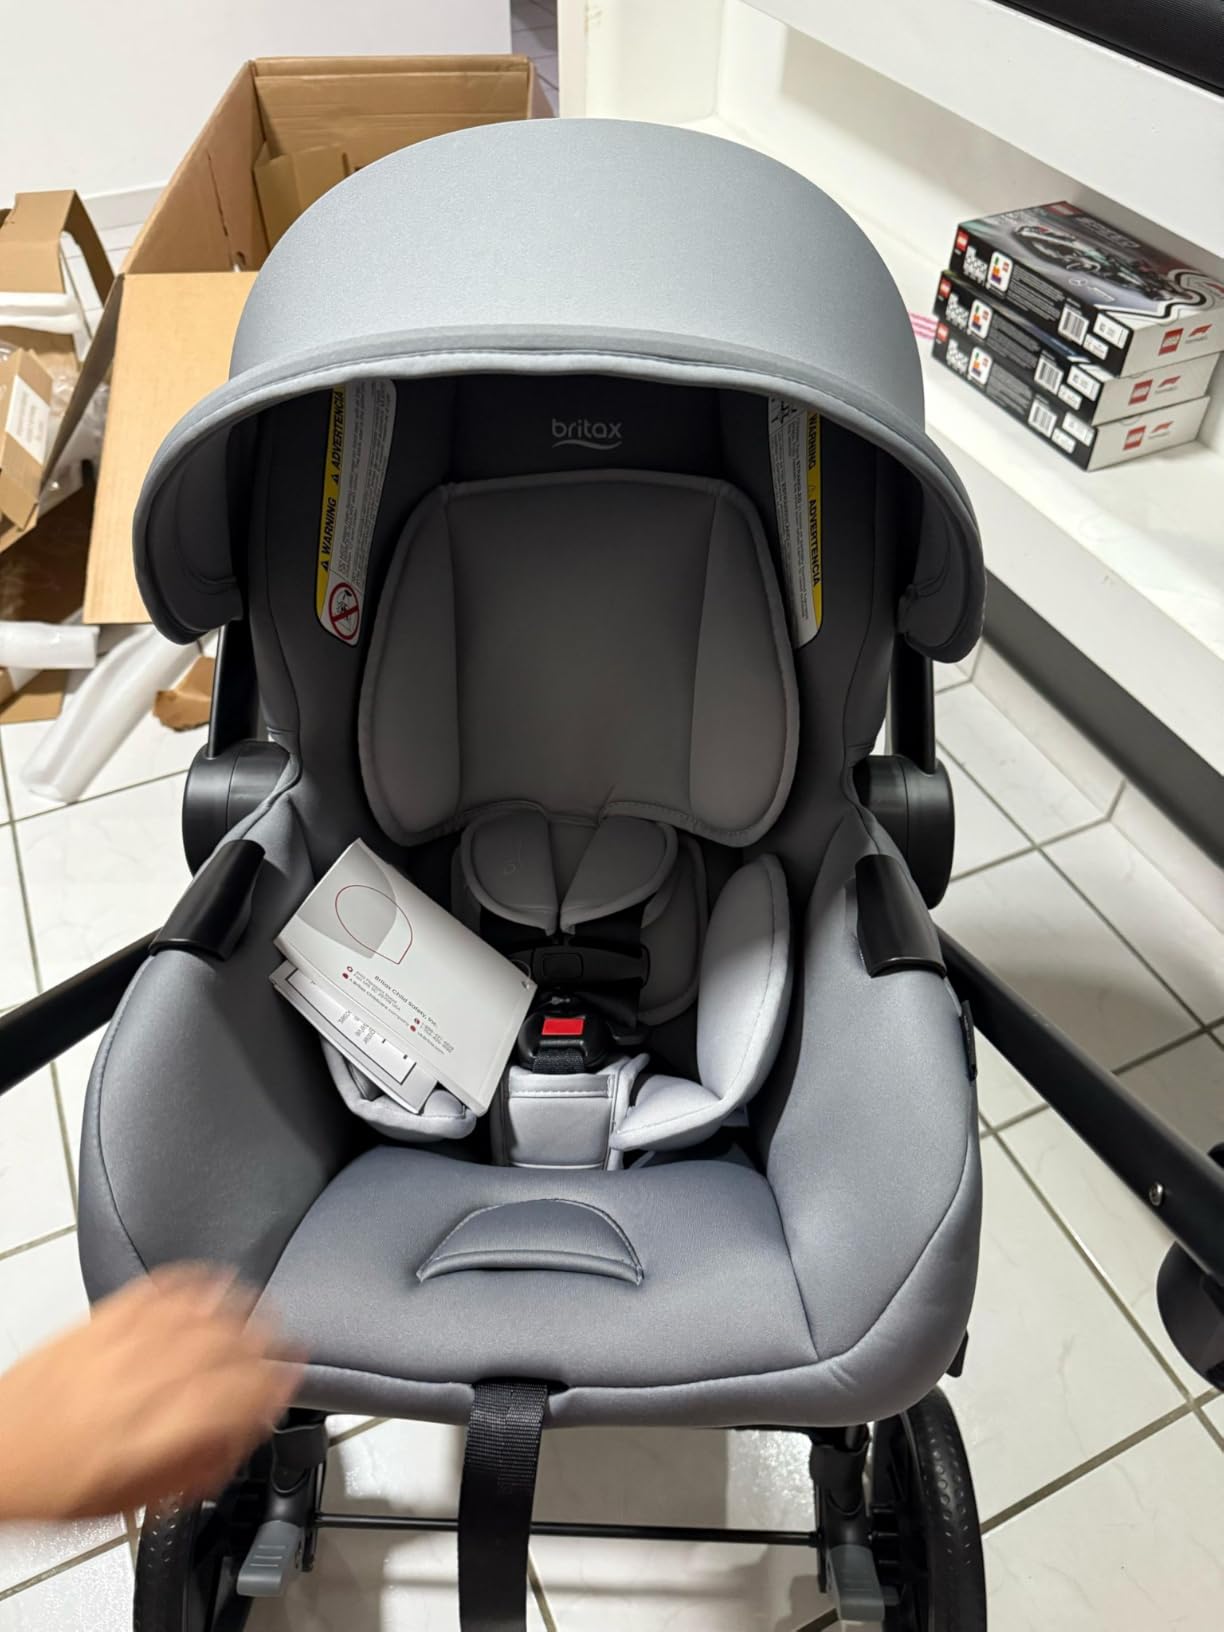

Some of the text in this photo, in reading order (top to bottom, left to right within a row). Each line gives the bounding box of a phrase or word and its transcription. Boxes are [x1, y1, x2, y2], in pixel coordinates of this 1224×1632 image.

[321, 391, 345, 555] WARNING ADVERTENCIA
[552, 418, 622, 439] britax
[808, 413, 821, 586] WARNING ADVERTENCIA
